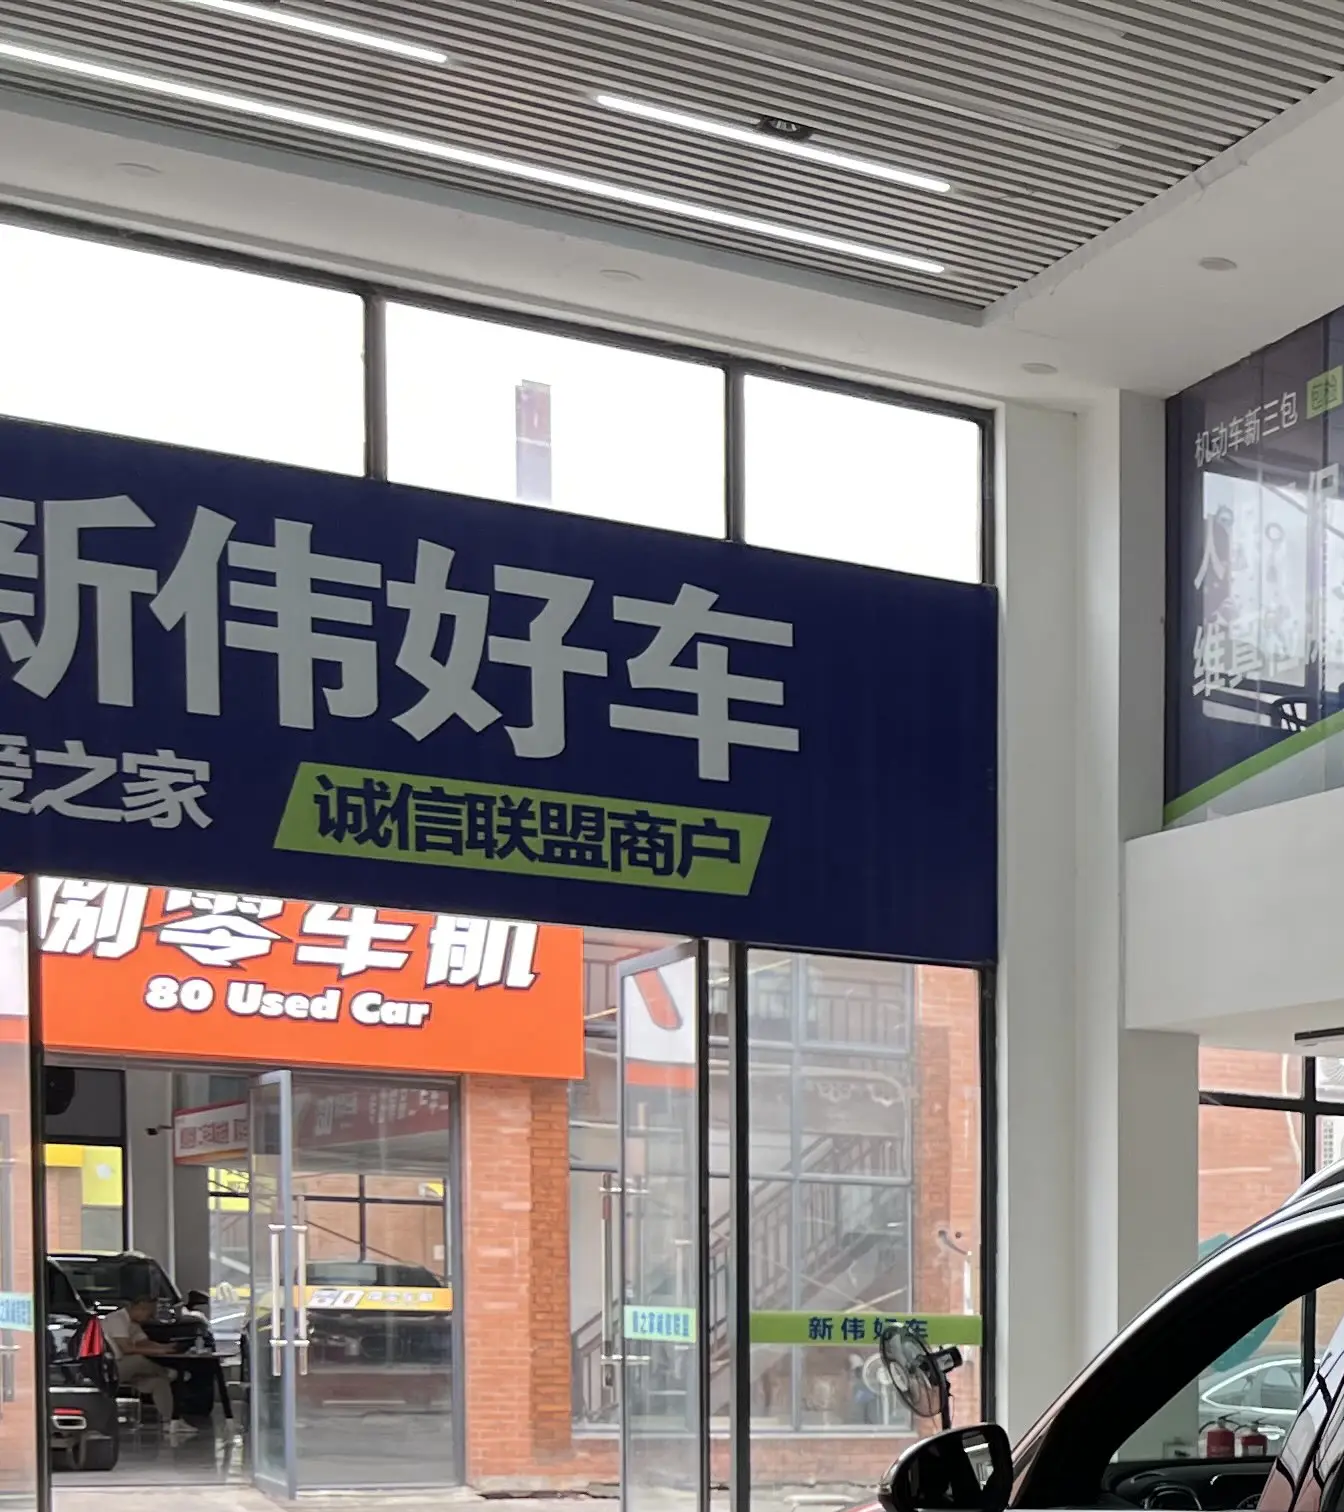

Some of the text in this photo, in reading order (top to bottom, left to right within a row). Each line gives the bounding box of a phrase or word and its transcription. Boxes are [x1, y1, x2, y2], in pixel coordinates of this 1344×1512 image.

[1195, 391, 1298, 468] 机动车新三包
[314, 774, 742, 878] 诚信联盟商户
[143, 974, 432, 1029] 80 Used Car
